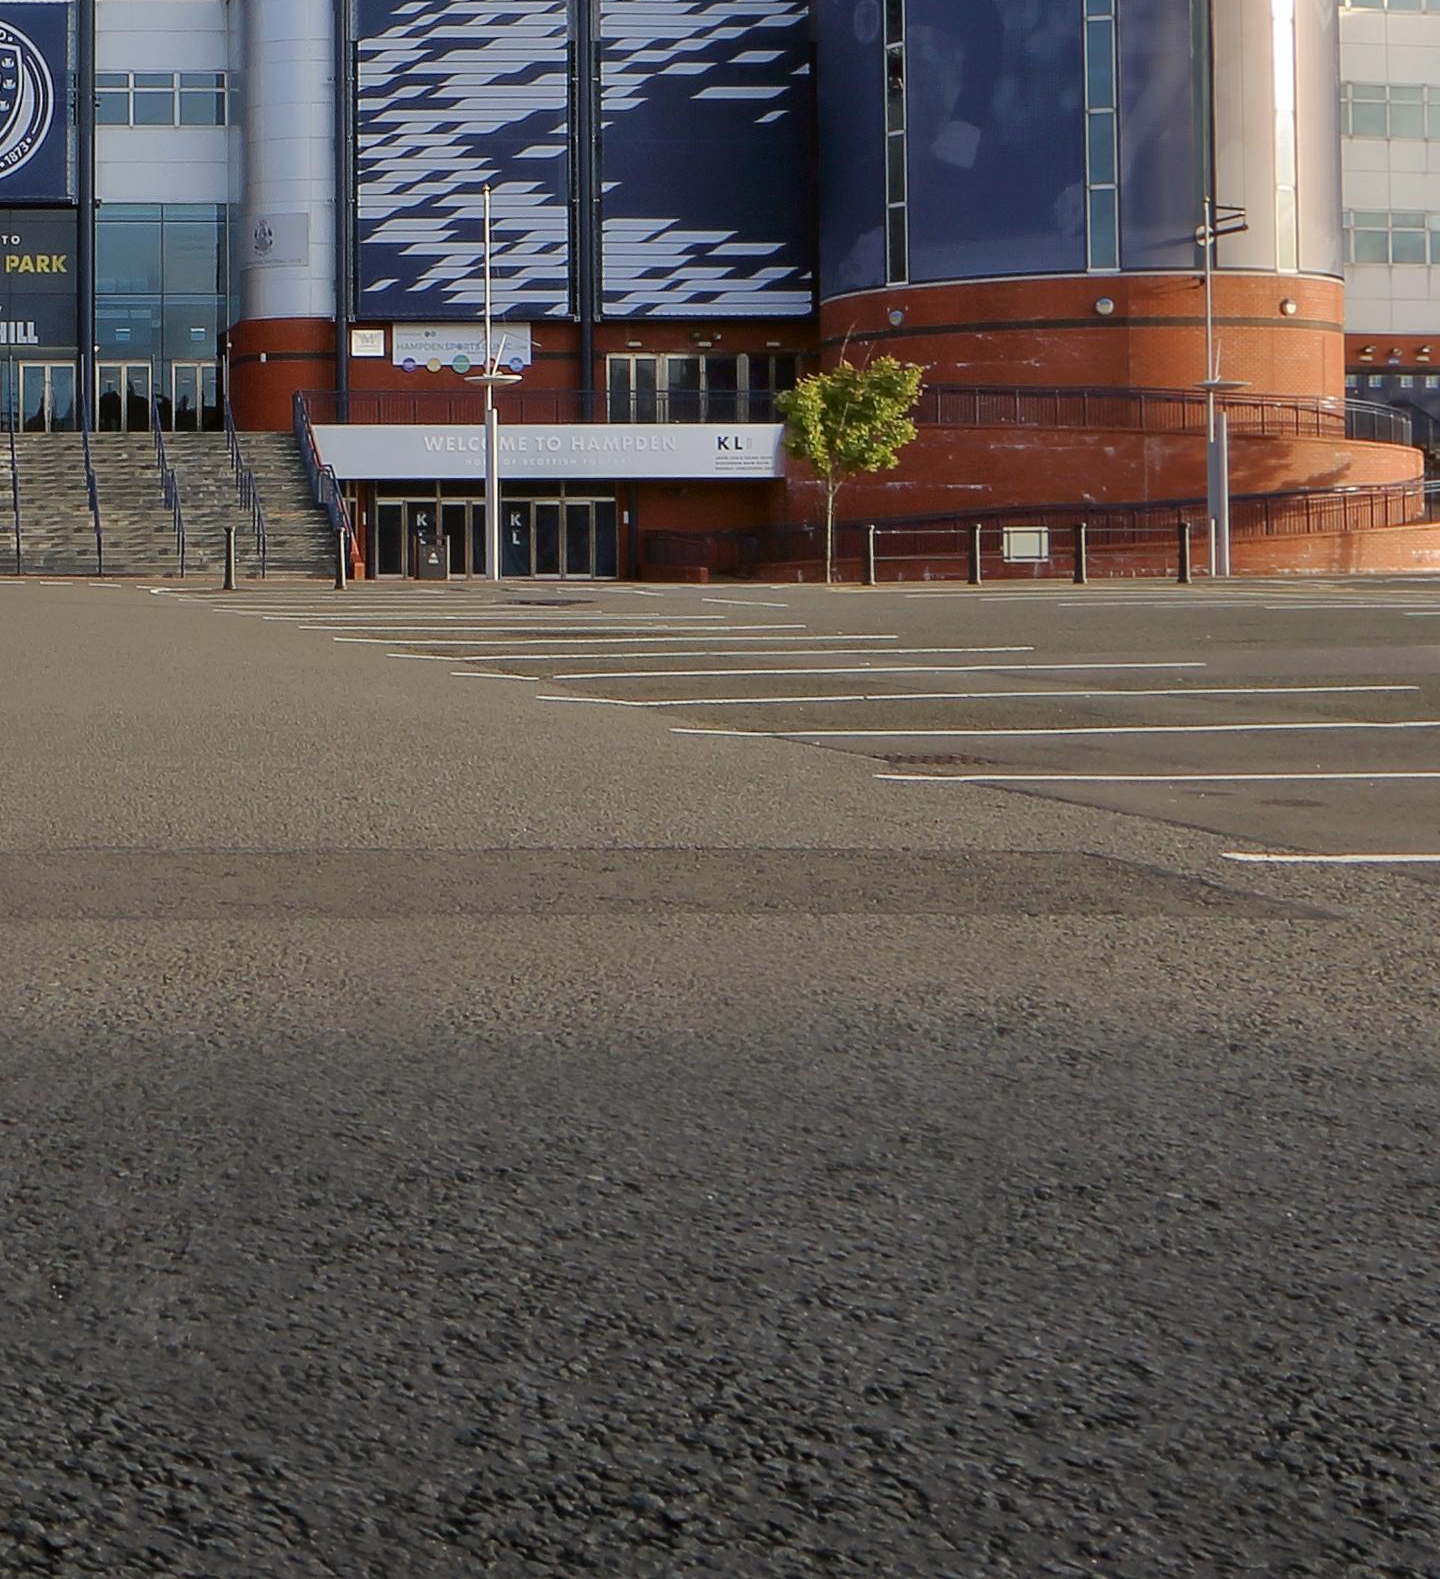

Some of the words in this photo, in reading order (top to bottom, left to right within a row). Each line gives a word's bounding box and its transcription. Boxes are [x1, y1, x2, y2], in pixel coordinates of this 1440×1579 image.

[3, 141, 30, 166] 1873
[1, 235, 21, 245] TO
[6, 255, 67, 273] PARK
[536, 437, 561, 452] TO
[572, 437, 676, 452] HAMPDEN
